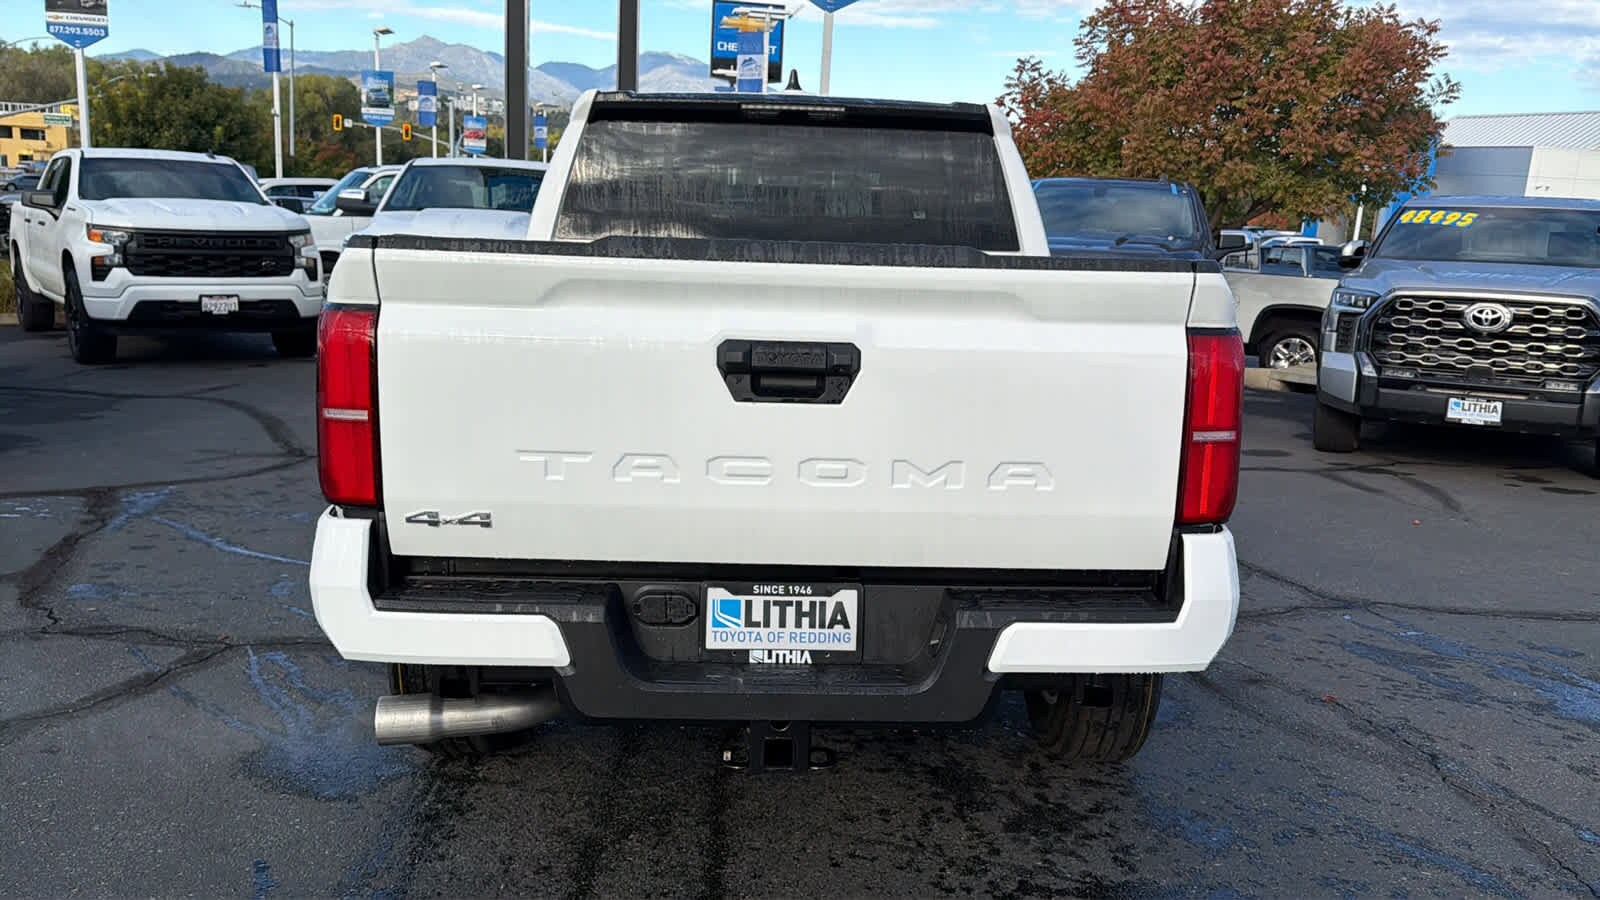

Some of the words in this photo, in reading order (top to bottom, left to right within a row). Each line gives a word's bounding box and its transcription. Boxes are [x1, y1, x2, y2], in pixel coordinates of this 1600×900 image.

[1400, 209, 1479, 227] 48495
[1461, 402, 1499, 414] LITHIA
[515, 449, 1055, 491] TACOMA
[752, 585, 785, 595] SINCE
[788, 585, 813, 595] 1946
[744, 599, 851, 629] LITHIA
[711, 630, 763, 643] TOYOTA
[767, 631, 785, 643] OF
[789, 631, 852, 643] REDDING
[763, 650, 813, 664] LITHIA
